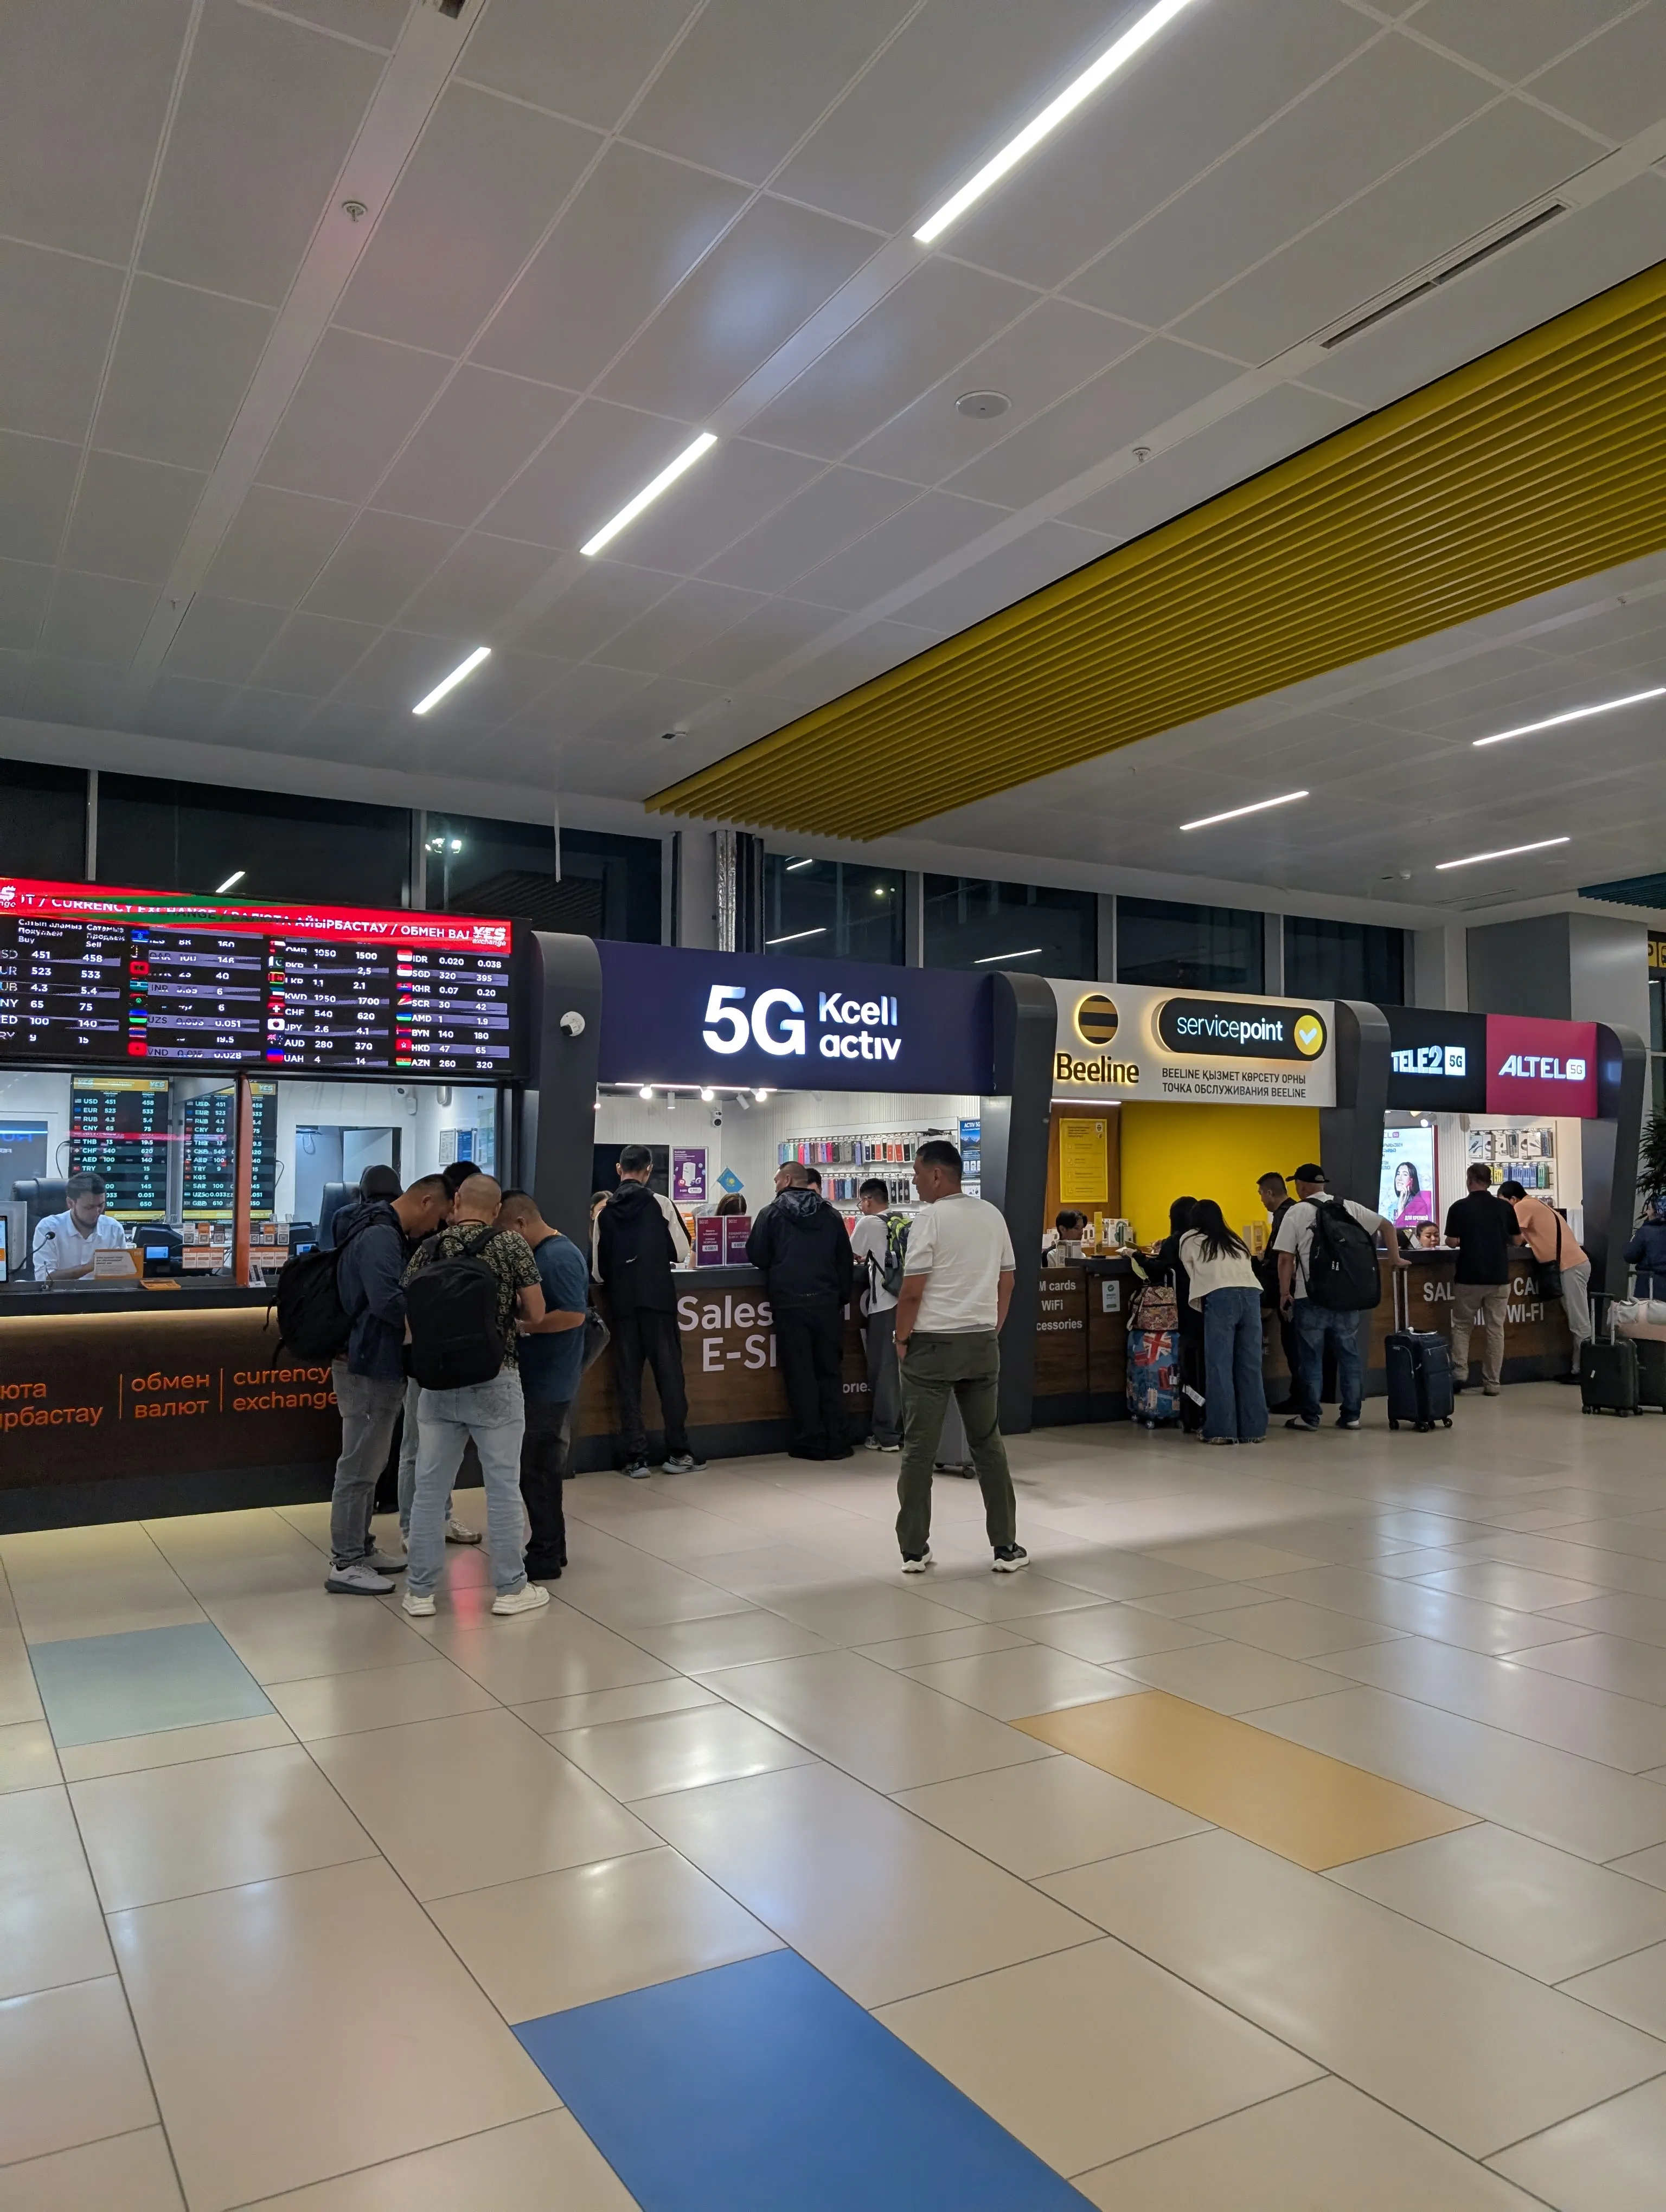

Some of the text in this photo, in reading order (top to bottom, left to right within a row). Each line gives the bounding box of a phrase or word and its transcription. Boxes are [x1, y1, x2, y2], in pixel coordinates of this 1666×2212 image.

[52, 899, 132, 912] CURRENCY
[401, 926, 445, 937] ОБМЕН
[31, 950, 50, 959] 451
[82, 954, 102, 962] 458
[315, 949, 377, 960] 1050 1500
[439, 957, 464, 965] 0.020
[477, 960, 501, 968] 0.038
[31, 967, 52, 976] 523
[81, 970, 100, 979] 533
[30, 984, 48, 992] 4.3
[81, 987, 97, 995] 5.4
[439, 986, 459, 994] 0.07
[80, 1003, 93, 1011] 75
[219, 1004, 225, 1012] 6
[358, 997, 380, 1005] 1700
[215, 1020, 241, 1028] 0.051
[703, 985, 897, 1055] 5G Kcell
[1177, 1014, 1283, 1044] servicepoint
[819, 1031, 901, 1060] activ
[1391, 1045, 1463, 1075] TELE2 5G
[1498, 1055, 1582, 1079] ALTEL 5G
[1057, 1053, 1139, 1083] Beeline
[1162, 1068, 1305, 1084] BEELINE ҚЫЗМЕТ КӨРСЕТУ ОРНЫ
[1163, 1083, 1306, 1098] ТОЧКА ОБСЛУЖИВАНИЯ BEELINE
[1049, 1280, 1077, 1291] cards
[677, 1295, 773, 1331] Sales
[1041, 1300, 1063, 1311] WiFi
[1507, 1302, 1543, 1323] WI-FI
[131, 1372, 209, 1392] обмен
[234, 1367, 331, 1385] currency
[1, 1383, 47, 1399] юта
[233, 1391, 338, 1411] exchange
[135, 1400, 209, 1418] валют
[0, 1406, 104, 1432] рбастау
